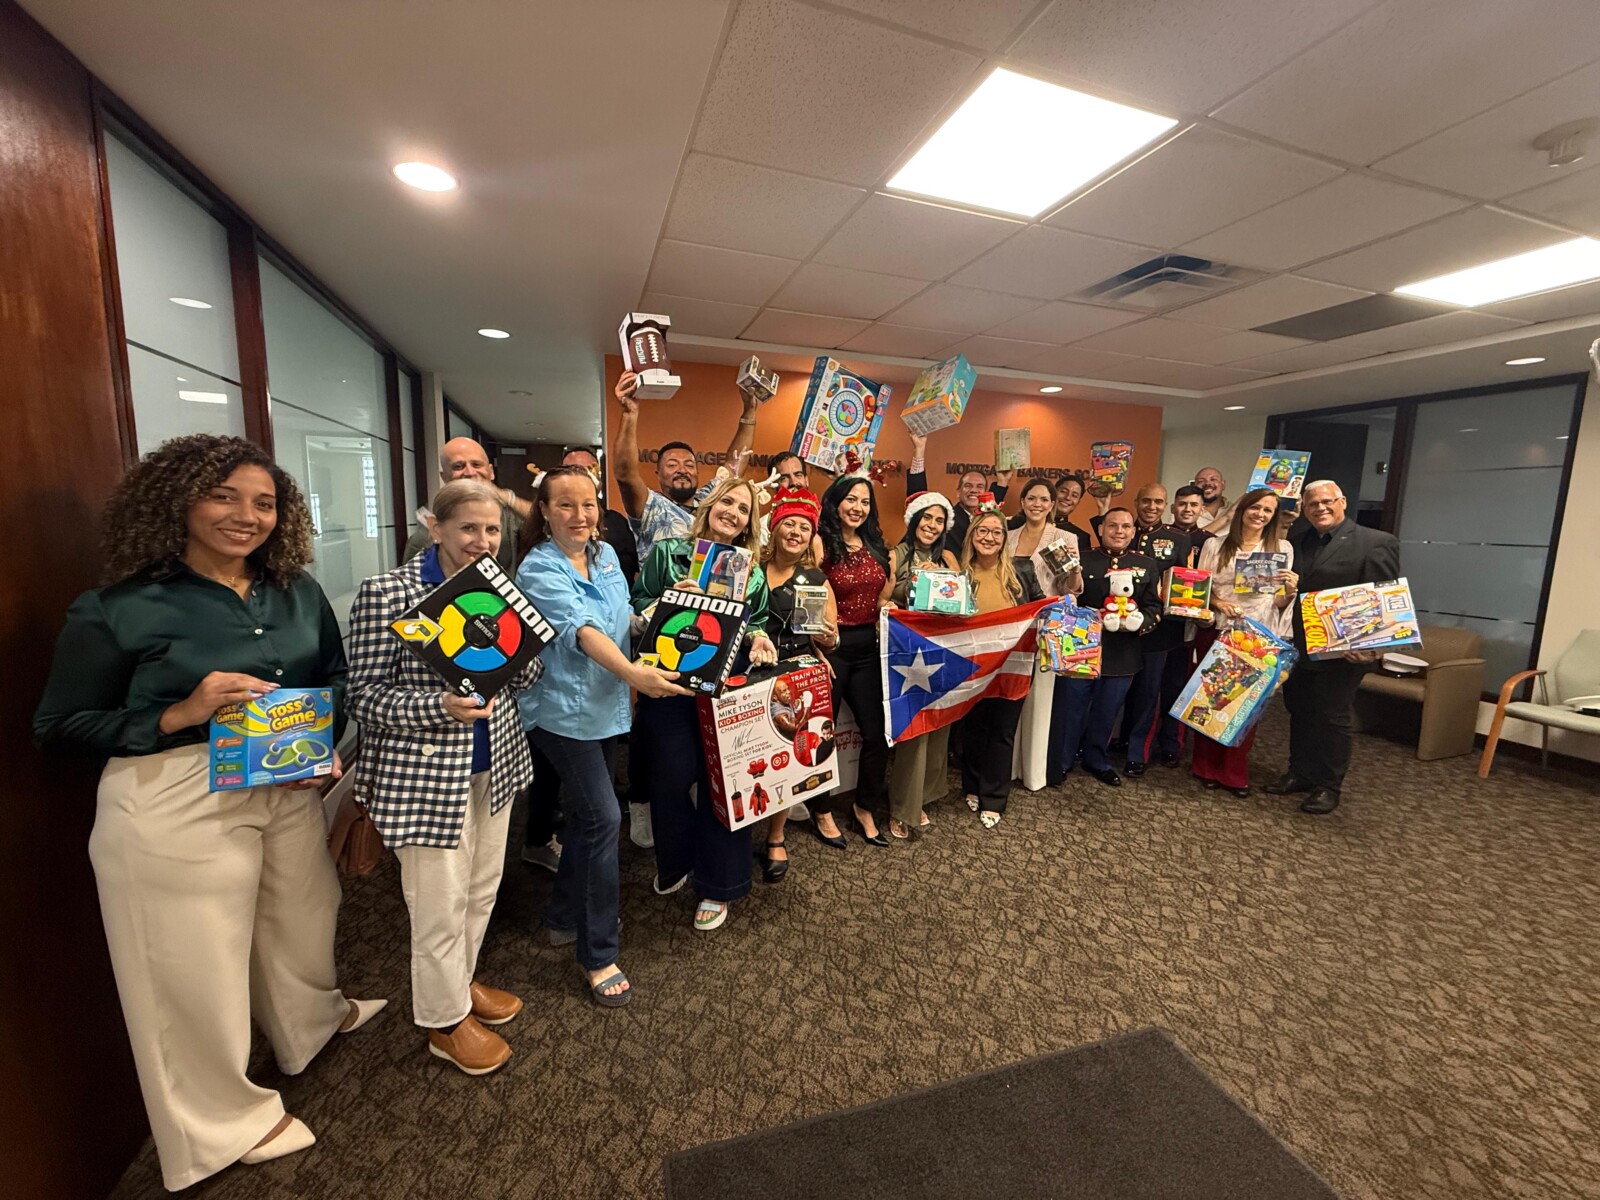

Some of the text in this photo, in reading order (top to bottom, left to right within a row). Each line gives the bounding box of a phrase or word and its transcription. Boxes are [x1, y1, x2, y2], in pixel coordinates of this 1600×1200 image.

[790, 672, 811, 682] TRAIN
[795, 674, 827, 689] THE PROS
[742, 693, 752, 701] 6+
[718, 707, 737, 719] MIKE
[738, 699, 763, 712] TYSON
[719, 707, 764, 728] KID'S BOXING
[720, 715, 765, 734] CHAMPION SET
